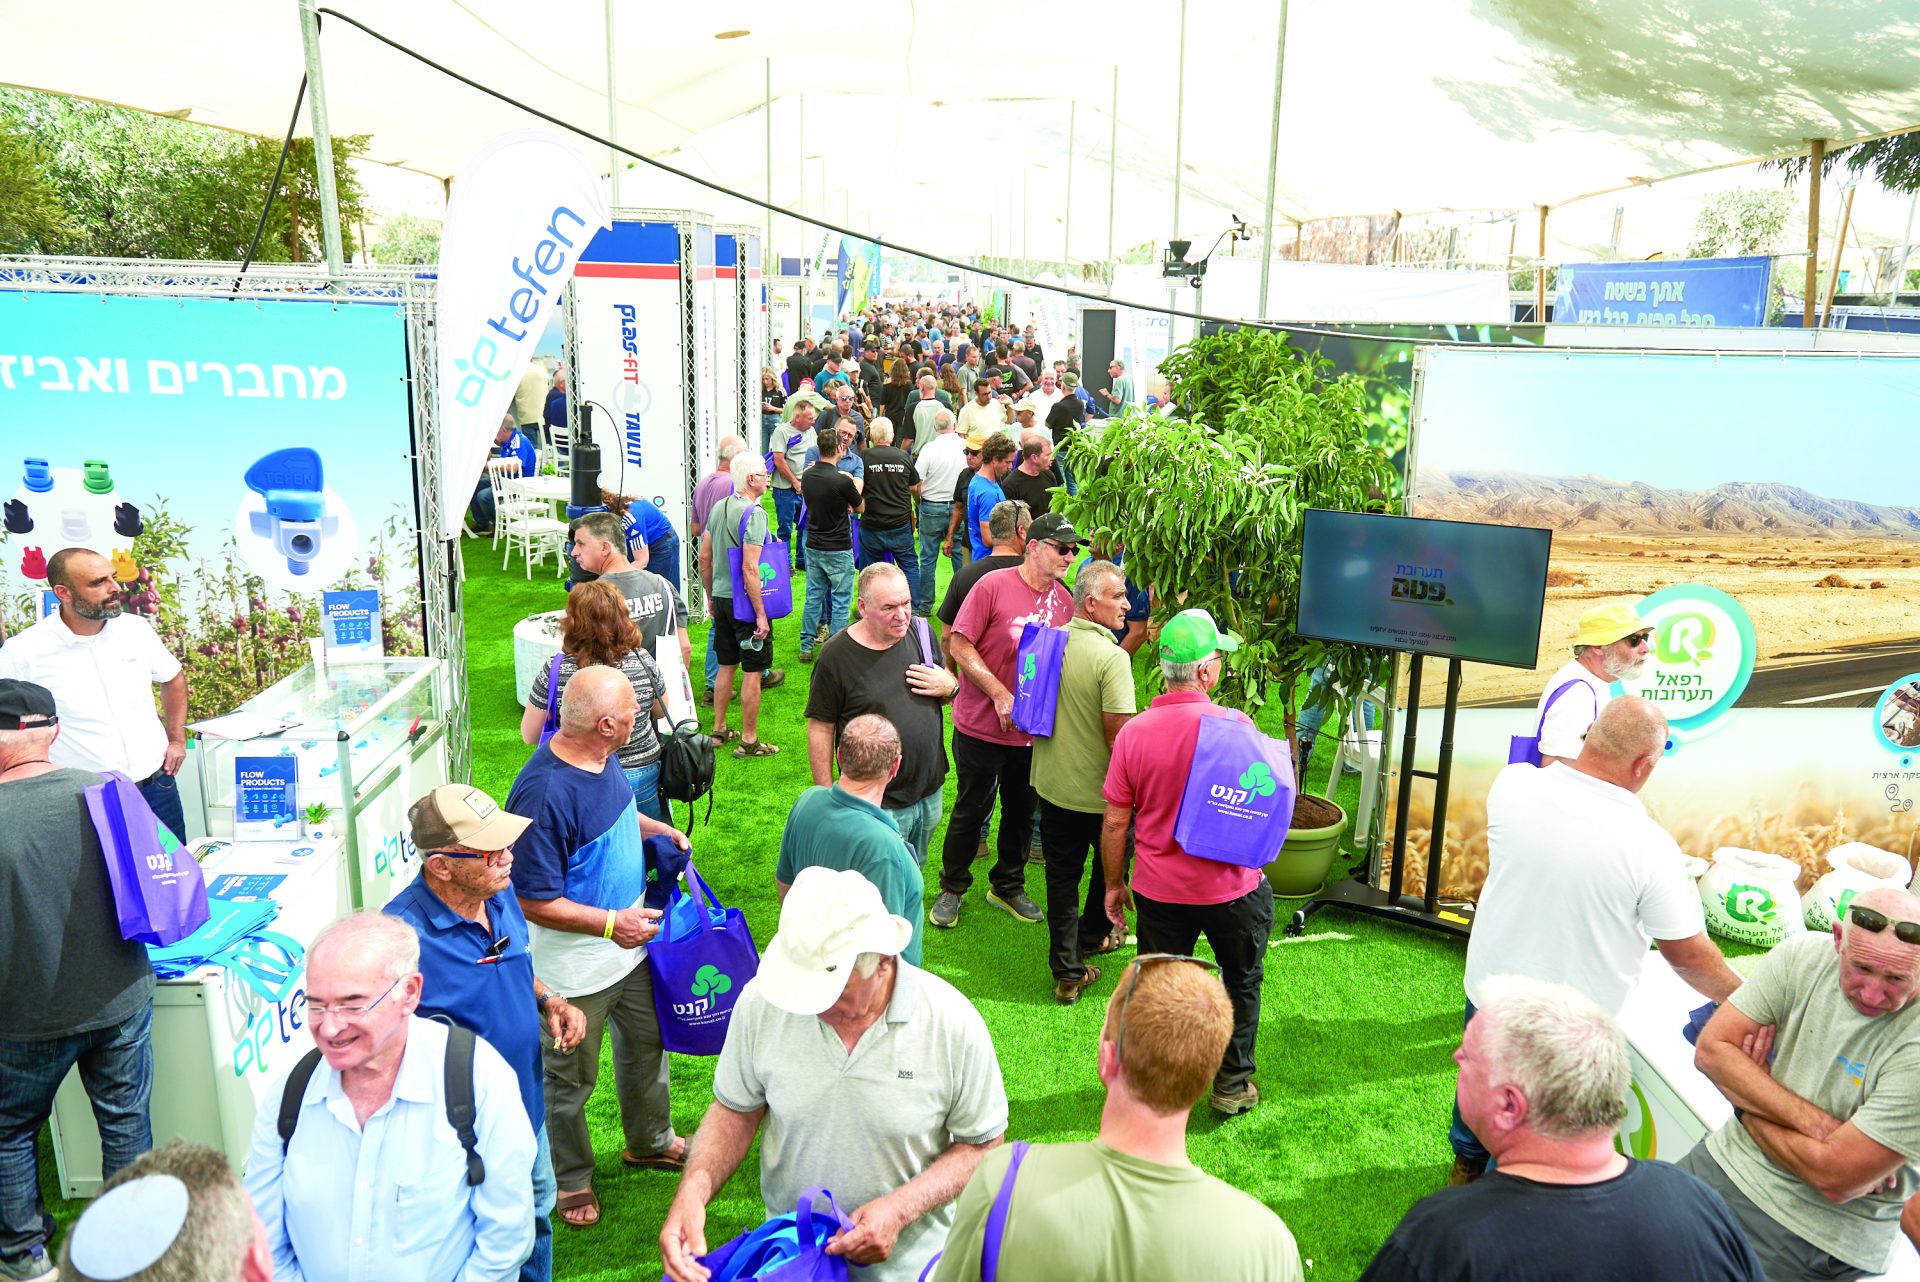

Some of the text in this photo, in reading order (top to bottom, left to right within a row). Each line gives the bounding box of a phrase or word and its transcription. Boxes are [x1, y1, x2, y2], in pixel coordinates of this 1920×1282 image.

[487, 207, 586, 342] tefen
[1604, 281, 1686, 307] אתך בשטח
[147, 359, 347, 400] מחברים
[626, 412, 642, 467] TAVLIT
[264, 471, 313, 486] TEFEN
[1395, 564, 1444, 579] תערובת
[1391, 577, 1446, 602] פטם
[328, 603, 350, 611] FLOW
[328, 609, 370, 617] PRODUCTS
[1656, 671, 1703, 686] רפאל
[1641, 689, 1714, 702] תערובות
[240, 771, 265, 779] FLOW
[240, 778, 286, 787] PRODUCTS
[1722, 922, 1768, 937] תערובות
[1725, 928, 1752, 944] Feed
[1756, 936, 1782, 945] Mills
